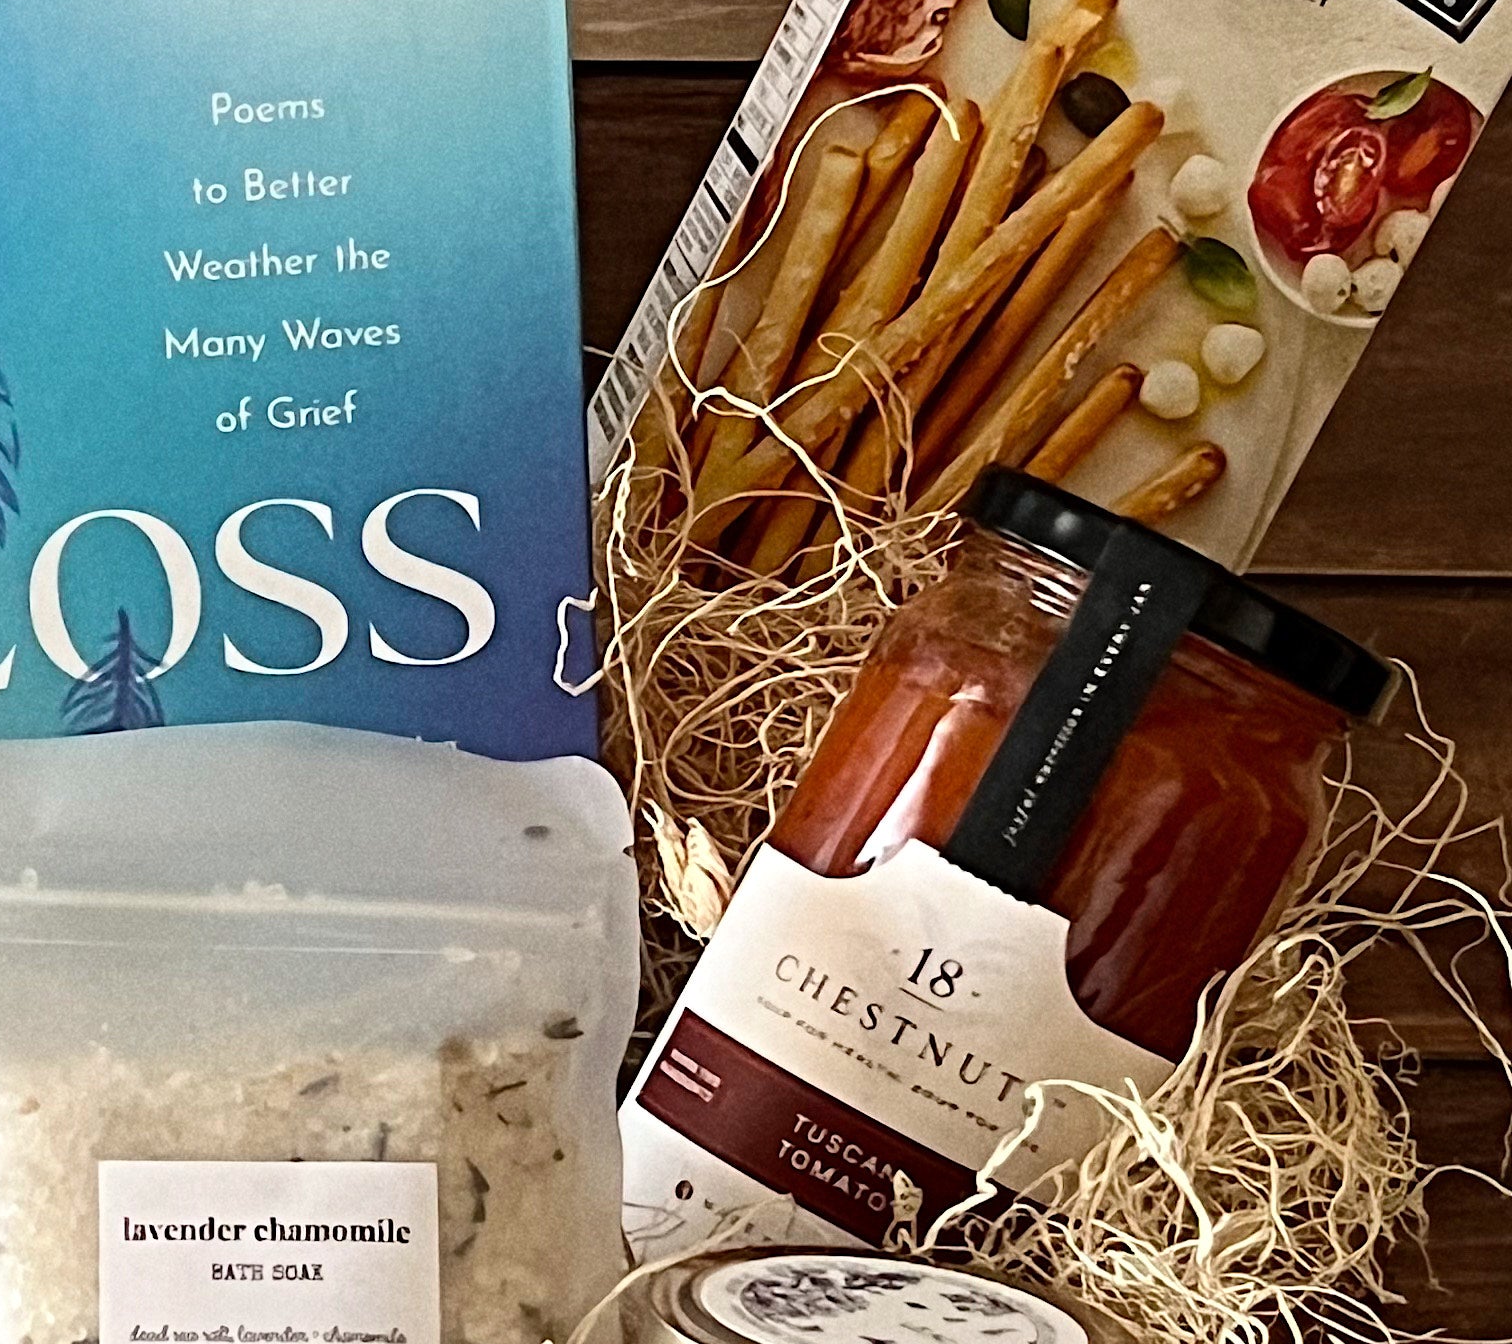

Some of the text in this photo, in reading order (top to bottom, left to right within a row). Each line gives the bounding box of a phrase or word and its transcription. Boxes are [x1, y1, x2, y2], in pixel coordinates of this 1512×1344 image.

[211, 92, 325, 126] Poems
[193, 169, 352, 205] to Better
[163, 238, 391, 283] Weather the
[164, 318, 402, 362] Many Waves
[216, 390, 358, 434] of Grief
[907, 947, 964, 998] 18
[793, 1113, 893, 1181] TUSCAN
[778, 1139, 887, 1212] TOMATO
[123, 1217, 411, 1244] lavender chamomile
[212, 1263, 324, 1281] BATH SOAK
